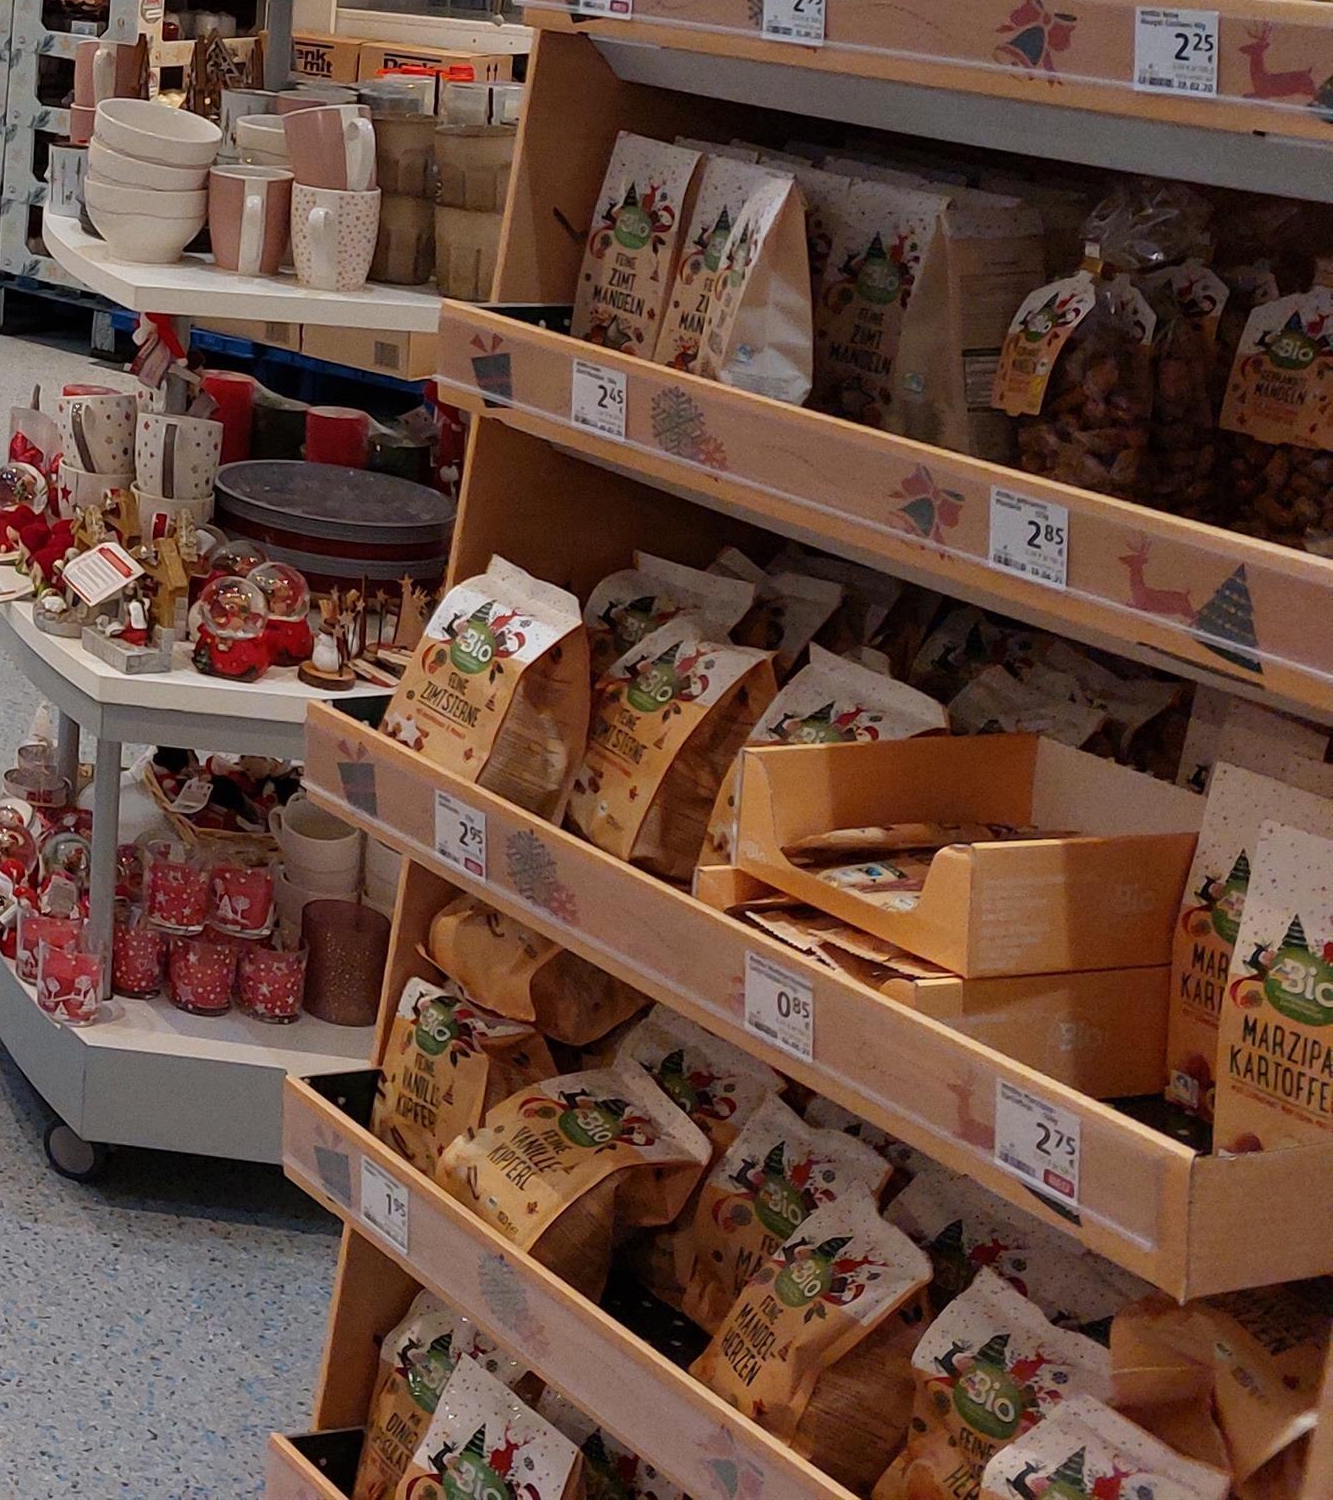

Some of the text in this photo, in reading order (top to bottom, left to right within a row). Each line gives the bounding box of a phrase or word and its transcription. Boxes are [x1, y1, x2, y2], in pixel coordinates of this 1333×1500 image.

[293, 47, 326, 64] enk
[608, 266, 638, 291] ZIMT
[592, 283, 646, 317] MANDELN
[447, 671, 468, 696] FEINE
[419, 679, 480, 729] ZIMTSTERNE
[1241, 1013, 1333, 1081] MARZIPA
[1228, 1046, 1333, 1105] KARTOFFE
[758, 1295, 783, 1325] FEINE
[720, 1327, 763, 1387] HERZEN
[963, 1369, 1016, 1424] Bio
[958, 1425, 998, 1463] FEINE
[941, 1463, 984, 1500] HER
